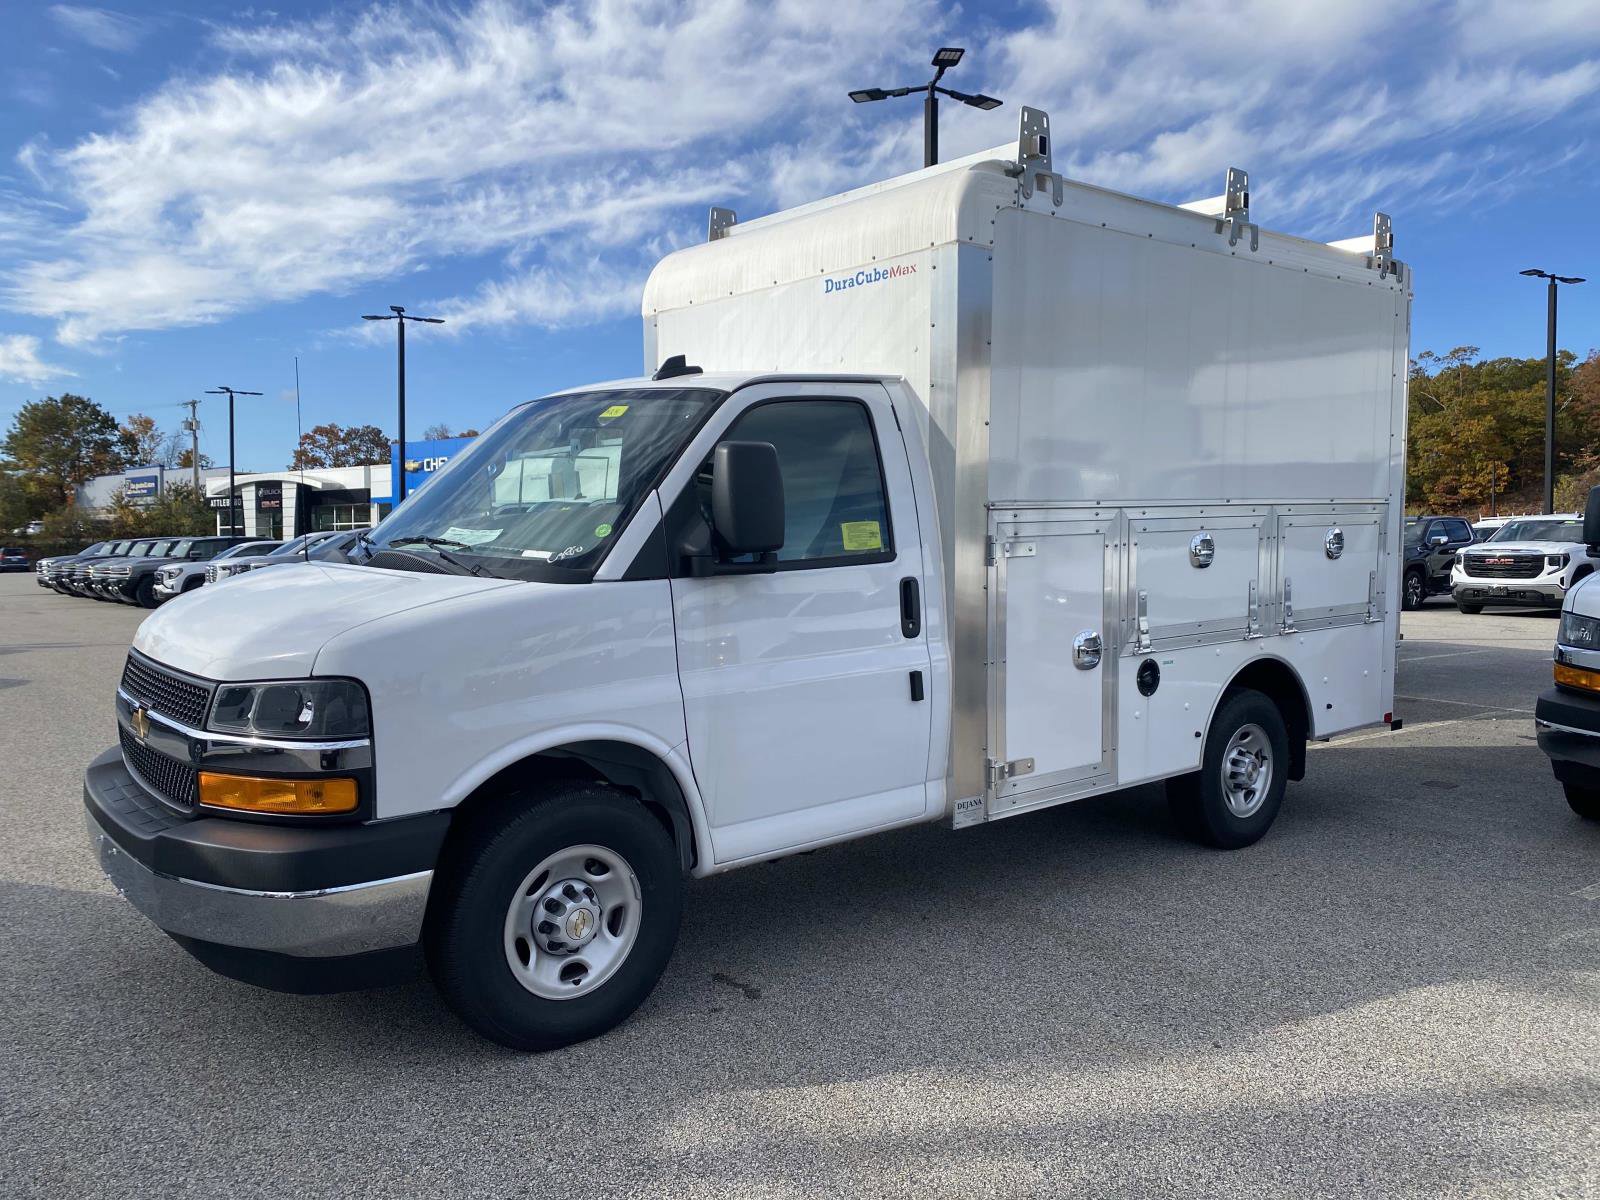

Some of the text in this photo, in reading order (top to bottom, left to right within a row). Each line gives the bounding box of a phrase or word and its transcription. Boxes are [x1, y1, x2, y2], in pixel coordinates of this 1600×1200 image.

[210, 498, 242, 507] ATTLEBRO
[261, 500, 280, 508] GMC
[957, 798, 982, 810] DEJANA
